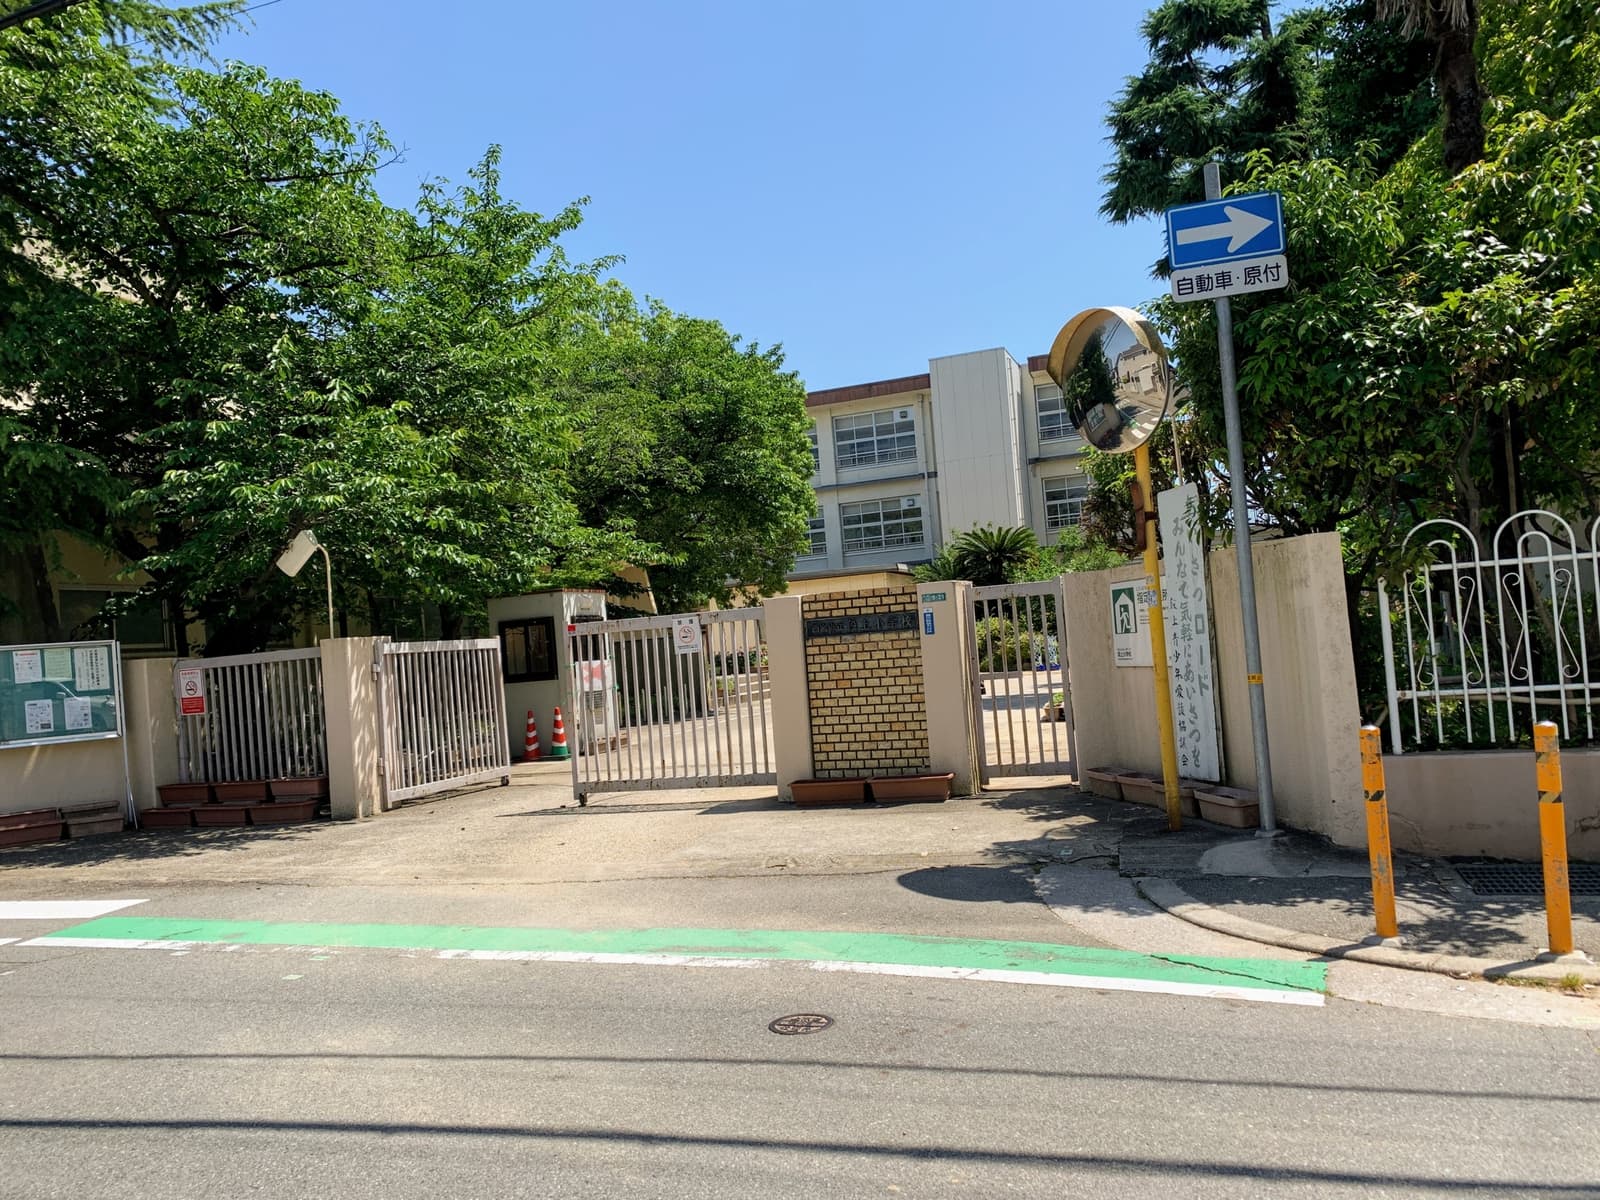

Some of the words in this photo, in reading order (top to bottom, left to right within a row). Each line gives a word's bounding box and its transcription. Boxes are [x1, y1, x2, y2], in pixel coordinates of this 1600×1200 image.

[1177, 262, 1281, 296] 自動車・原付
